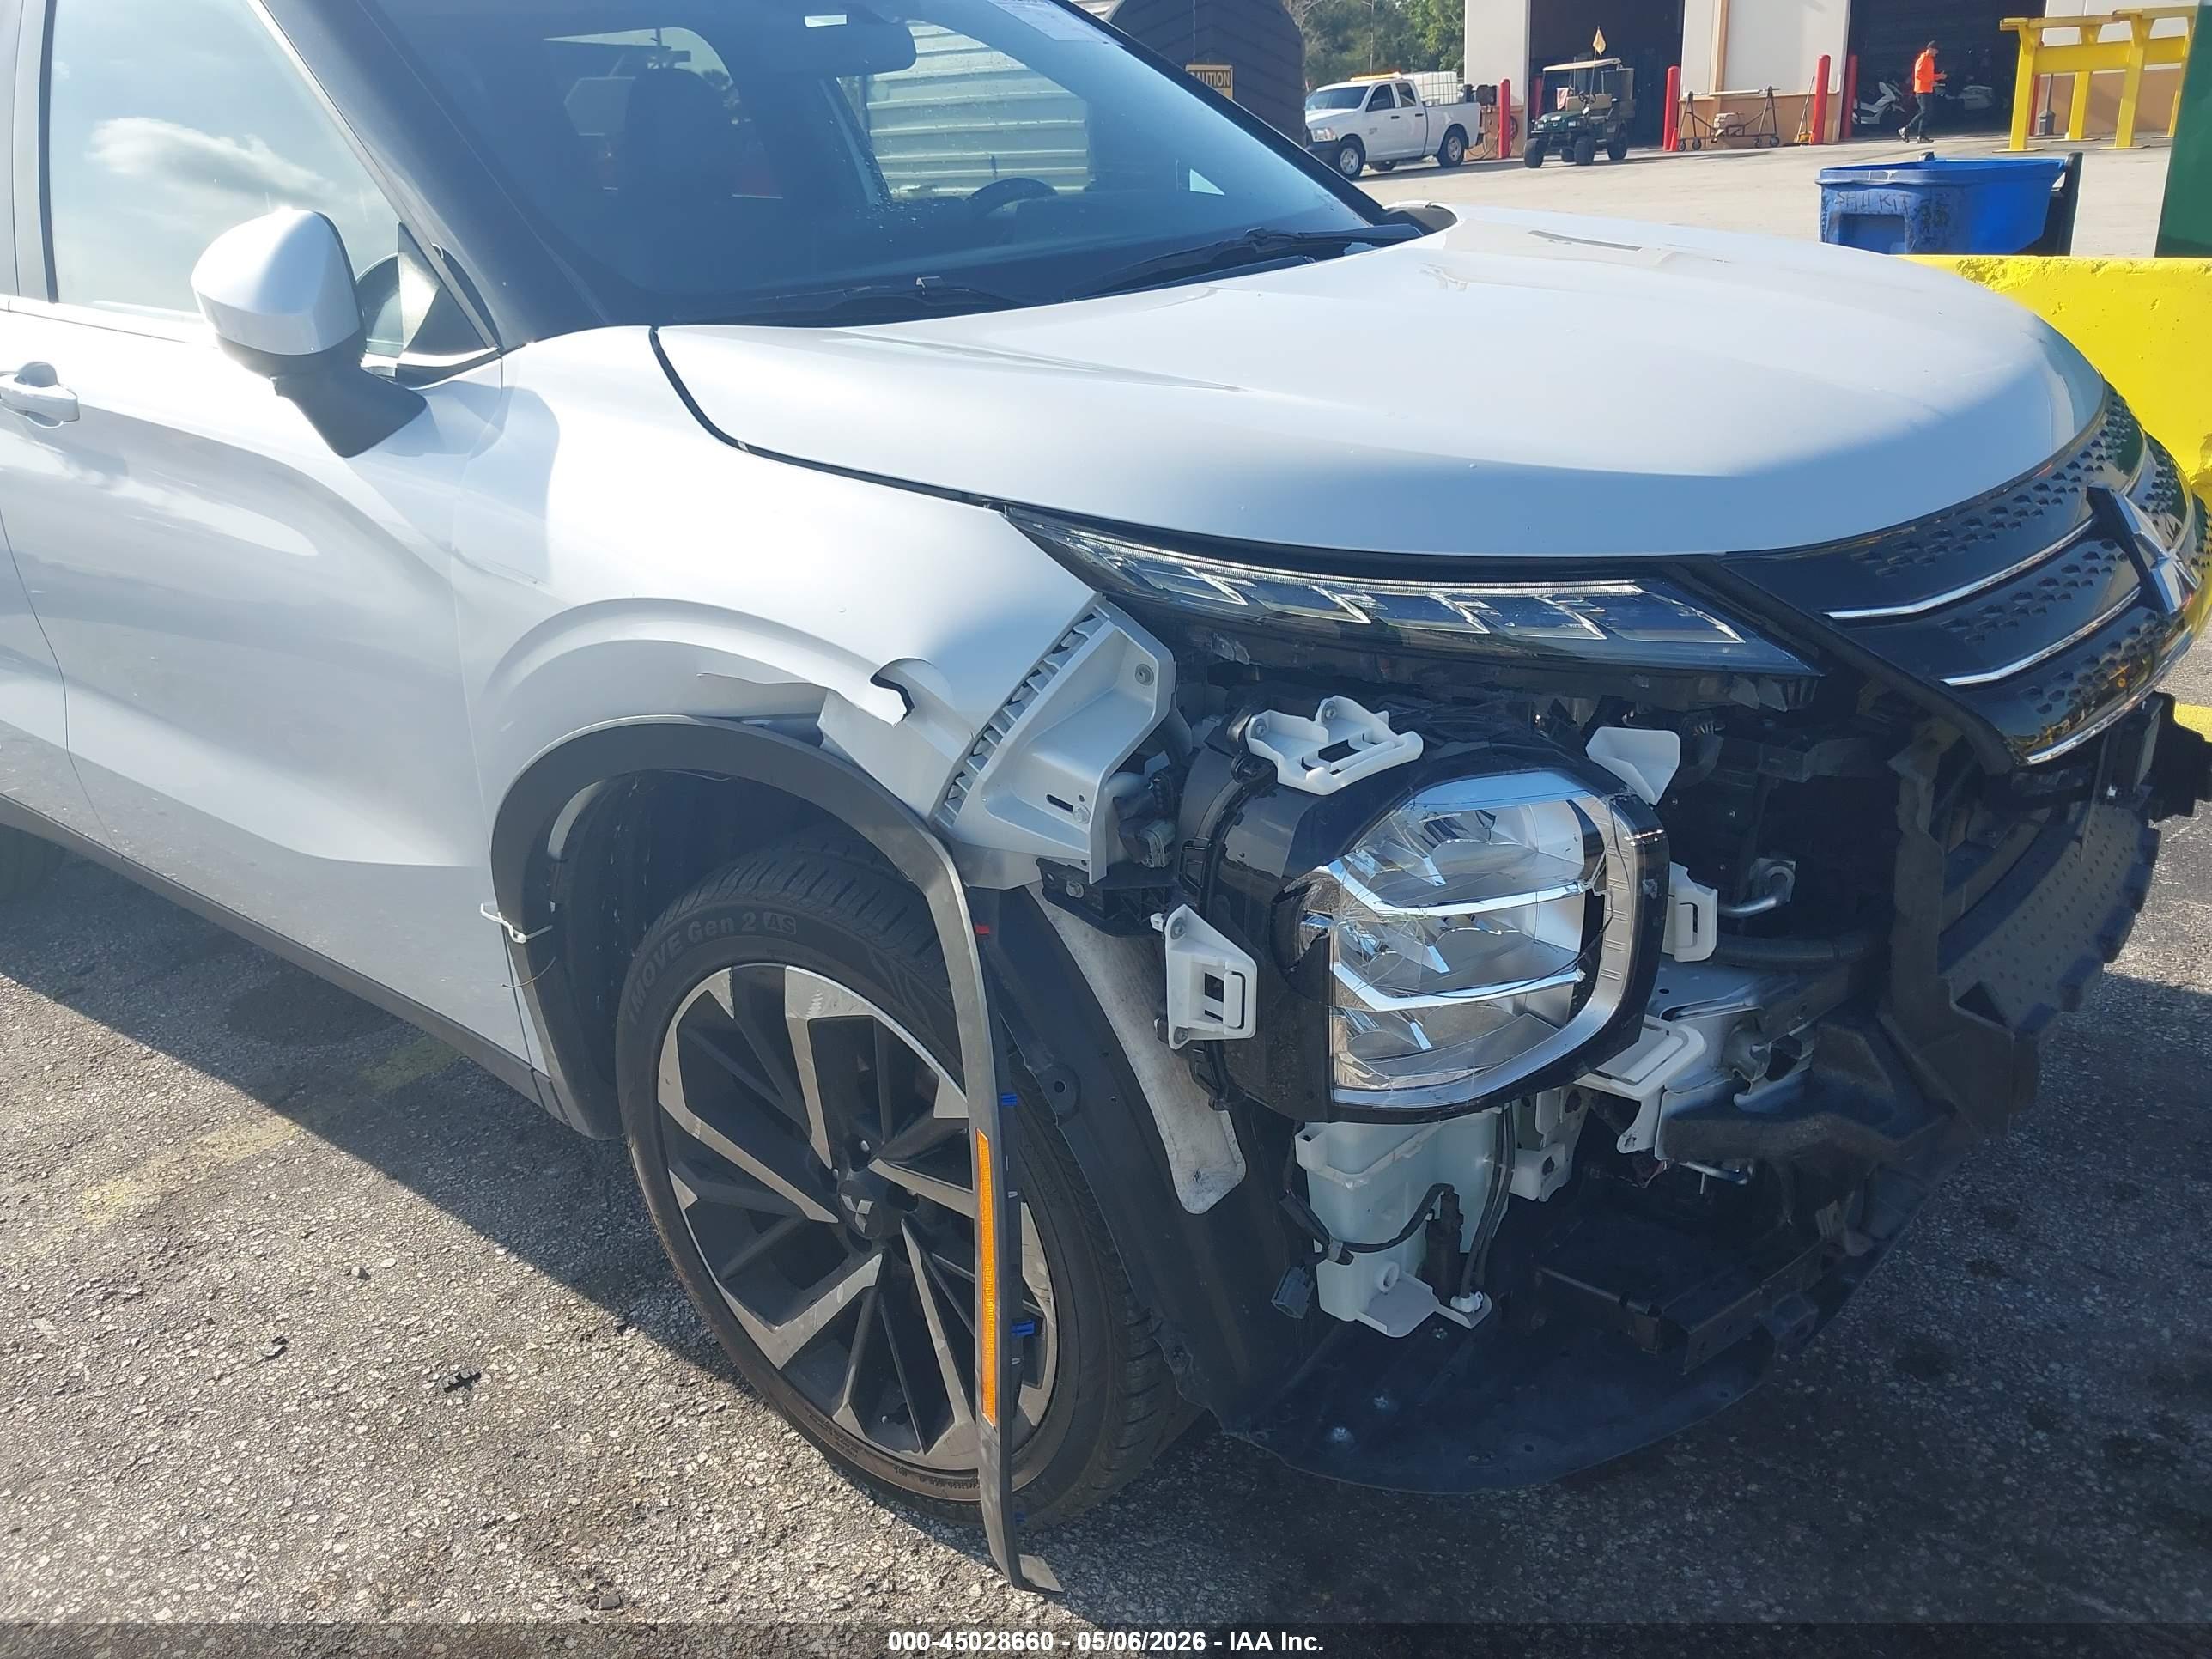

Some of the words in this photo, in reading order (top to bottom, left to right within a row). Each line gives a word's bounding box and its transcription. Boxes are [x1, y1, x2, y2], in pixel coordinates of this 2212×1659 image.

[688, 916, 735, 943] Gen
[742, 912, 757, 932] 2
[764, 912, 796, 933] AS
